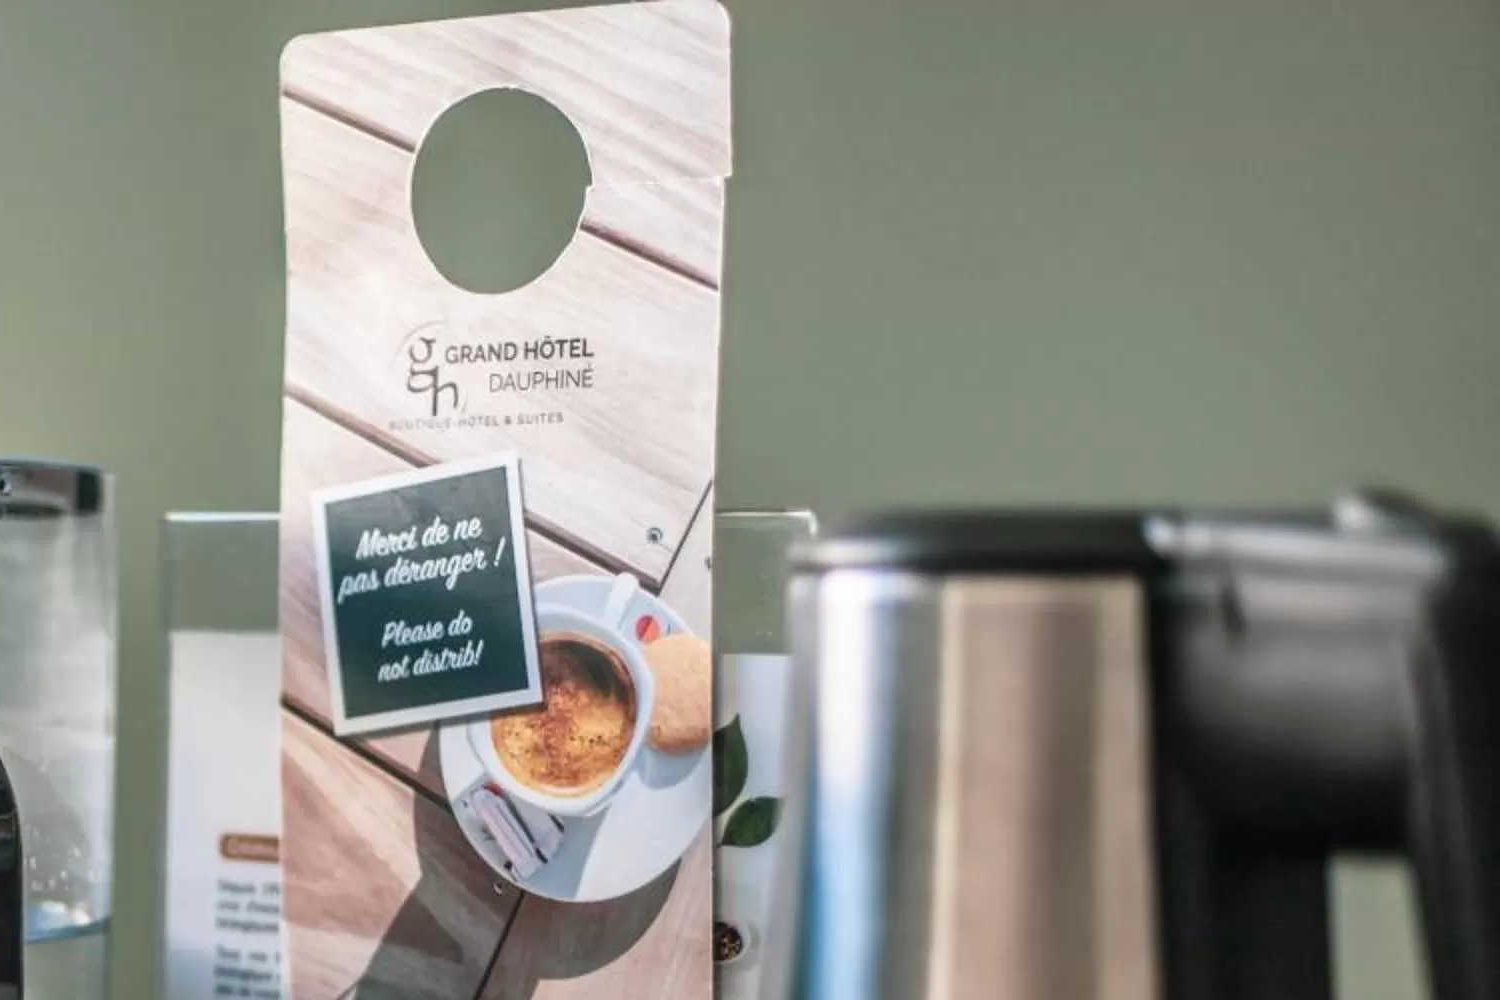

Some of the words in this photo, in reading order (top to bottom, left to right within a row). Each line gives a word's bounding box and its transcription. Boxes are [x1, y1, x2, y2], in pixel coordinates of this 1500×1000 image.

[445, 342, 518, 364] GRAND
[523, 336, 595, 361] HÔTEL
[488, 363, 595, 393] DAUPHINÉ
[517, 411, 564, 425] SUITES
[355, 525, 418, 560] Merci
[421, 514, 449, 546] de
[453, 516, 483, 540] ne
[336, 569, 380, 606] pas
[384, 547, 486, 590] déranger
[493, 536, 506, 567] !
[381, 621, 444, 648] Please
[448, 609, 473, 637] do
[377, 655, 409, 682] not
[413, 639, 484, 675] distrib!
